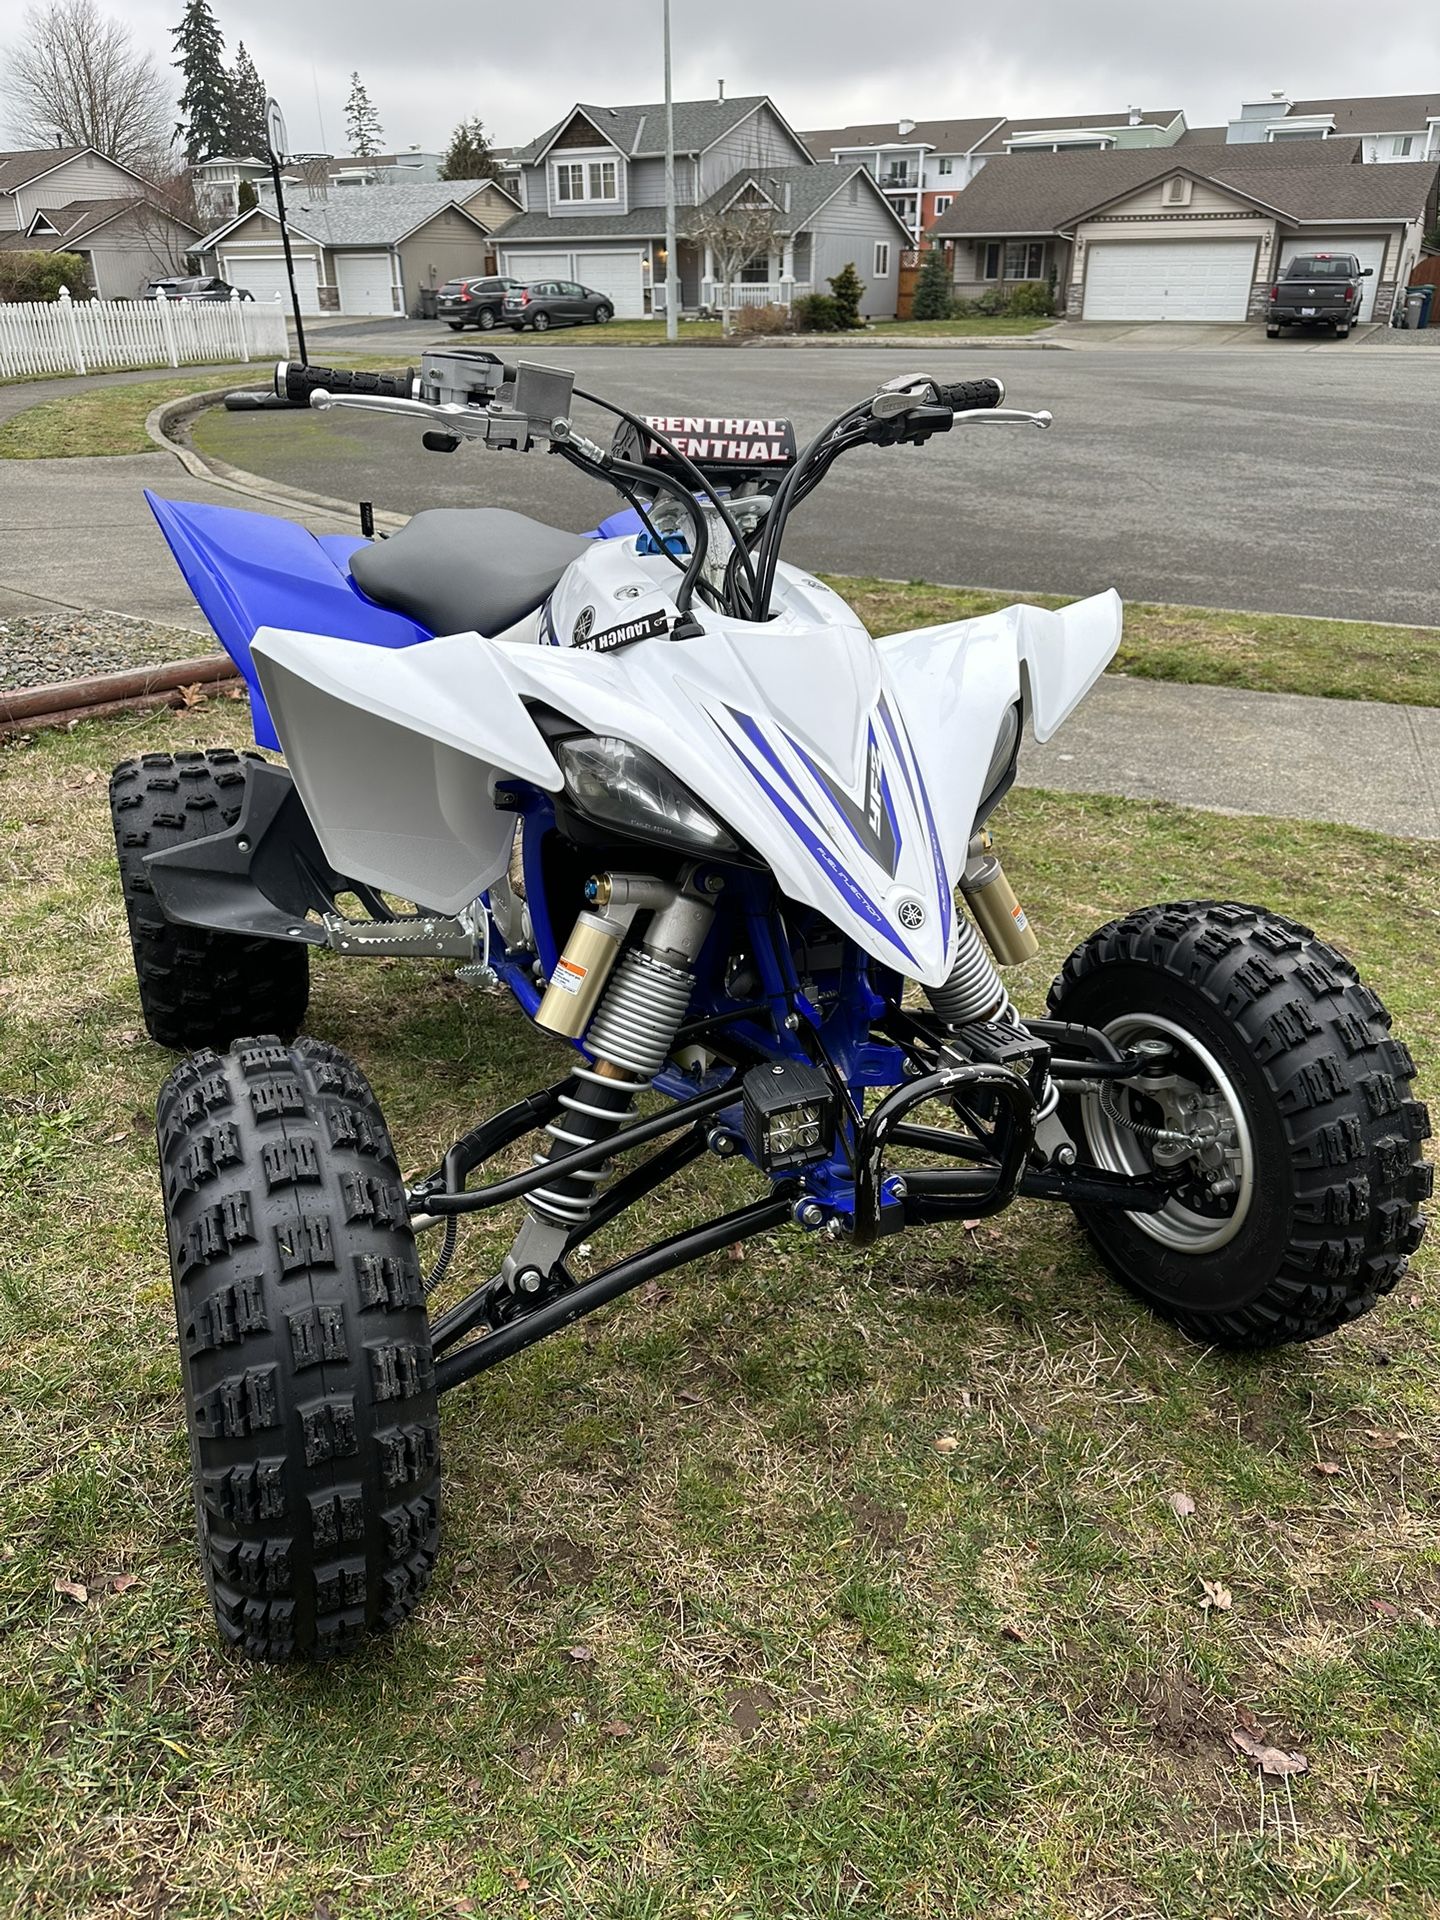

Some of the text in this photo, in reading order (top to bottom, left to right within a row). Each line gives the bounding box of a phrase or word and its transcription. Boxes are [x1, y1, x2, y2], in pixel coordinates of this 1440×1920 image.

[645, 416, 785, 436] RENTHAL
[599, 620, 651, 649] LAUNCH
[817, 847, 882, 922] FUEL INJECTION
